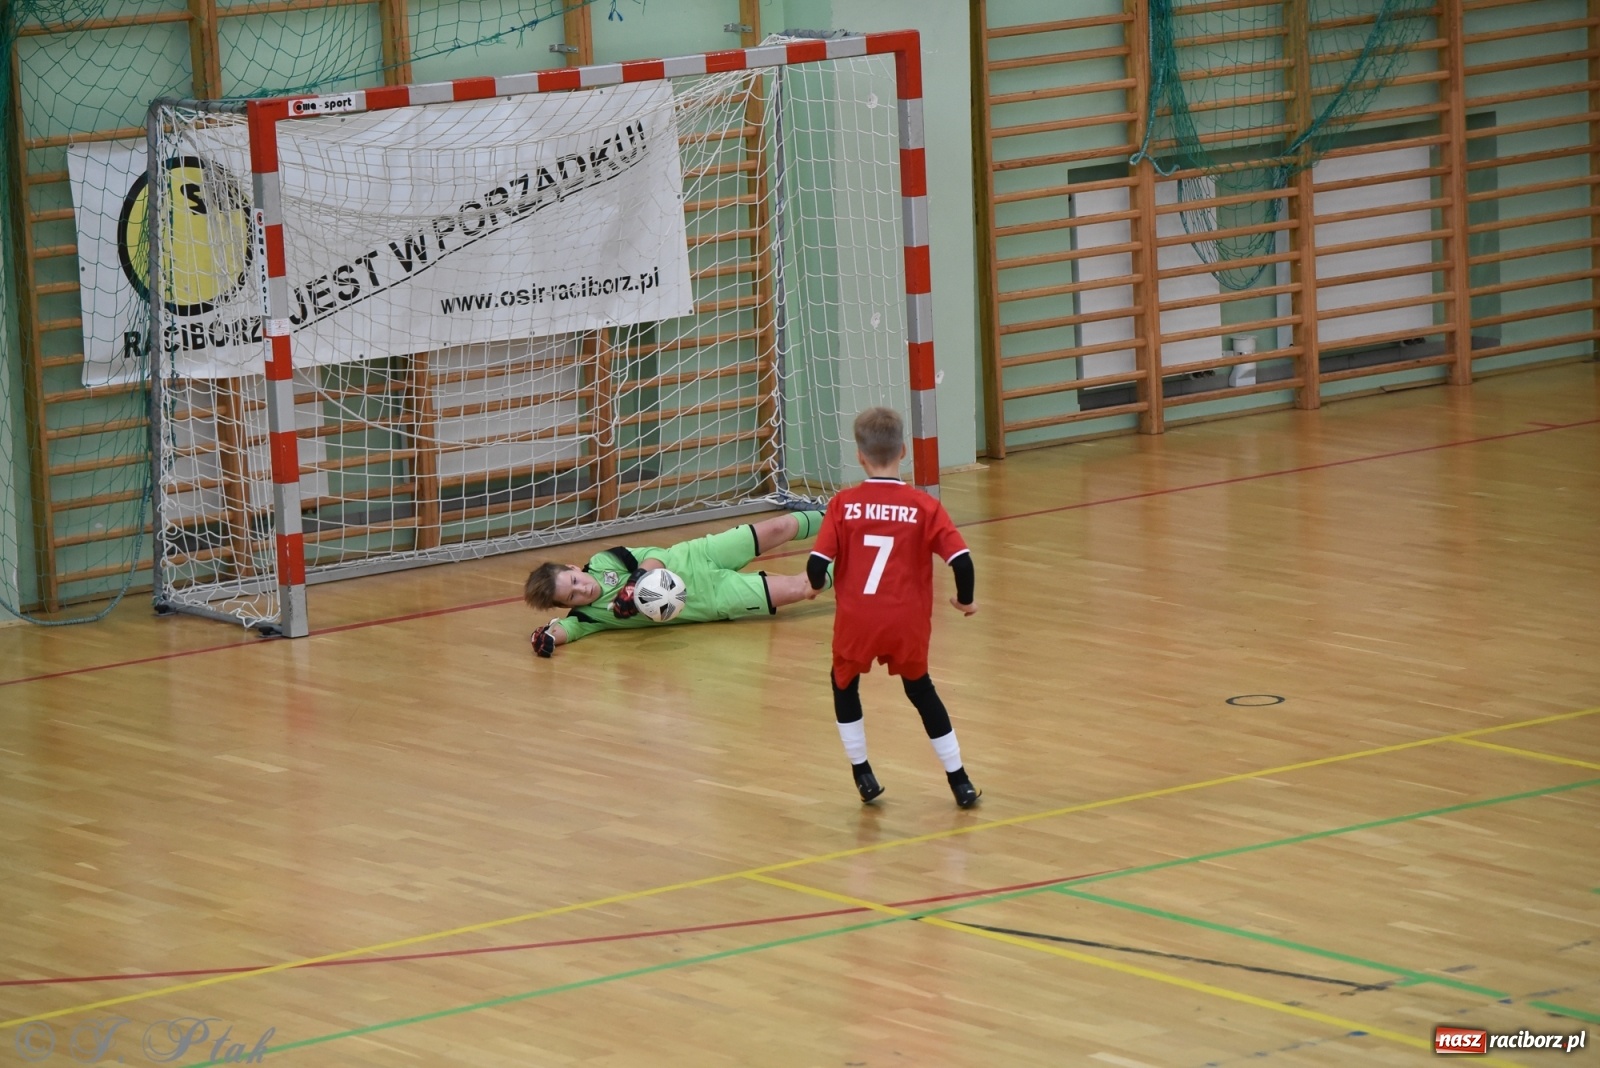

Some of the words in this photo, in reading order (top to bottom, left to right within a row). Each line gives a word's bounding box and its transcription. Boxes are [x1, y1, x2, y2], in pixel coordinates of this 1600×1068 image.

[325, 97, 352, 110] sport
[289, 250, 380, 325] JEST
[388, 229, 428, 273] W
[844, 503, 862, 520] ZS
[865, 503, 918, 524] KIETRZ
[863, 534, 894, 595] 7
